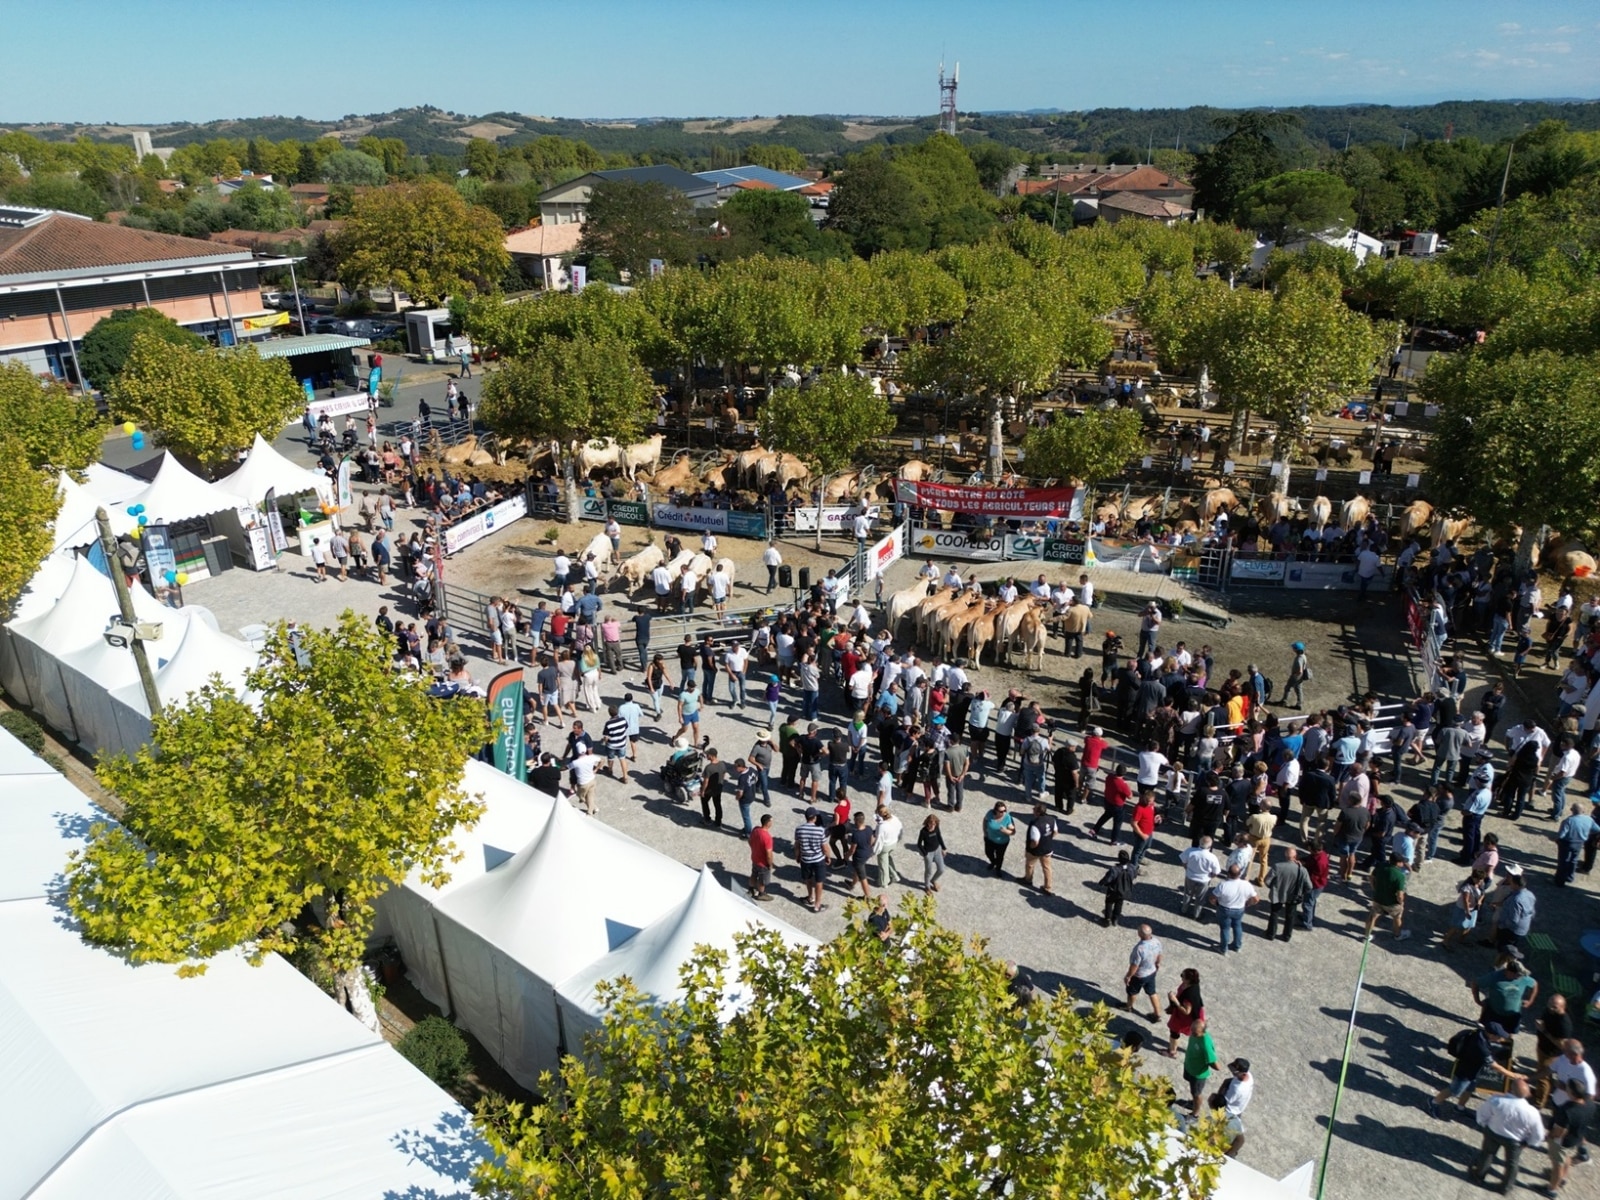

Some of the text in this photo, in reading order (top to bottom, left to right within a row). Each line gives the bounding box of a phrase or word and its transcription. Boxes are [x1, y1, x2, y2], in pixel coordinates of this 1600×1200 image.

[985, 491, 997, 500] AU
[921, 497, 933, 507] DE
[935, 498, 959, 508] TOUS
[961, 501, 980, 510] LES
[982, 501, 1055, 512] AGRICULTEURS
[657, 509, 724, 526] Crédit Mutuel
[1045, 550, 1083, 561] AGRICO
